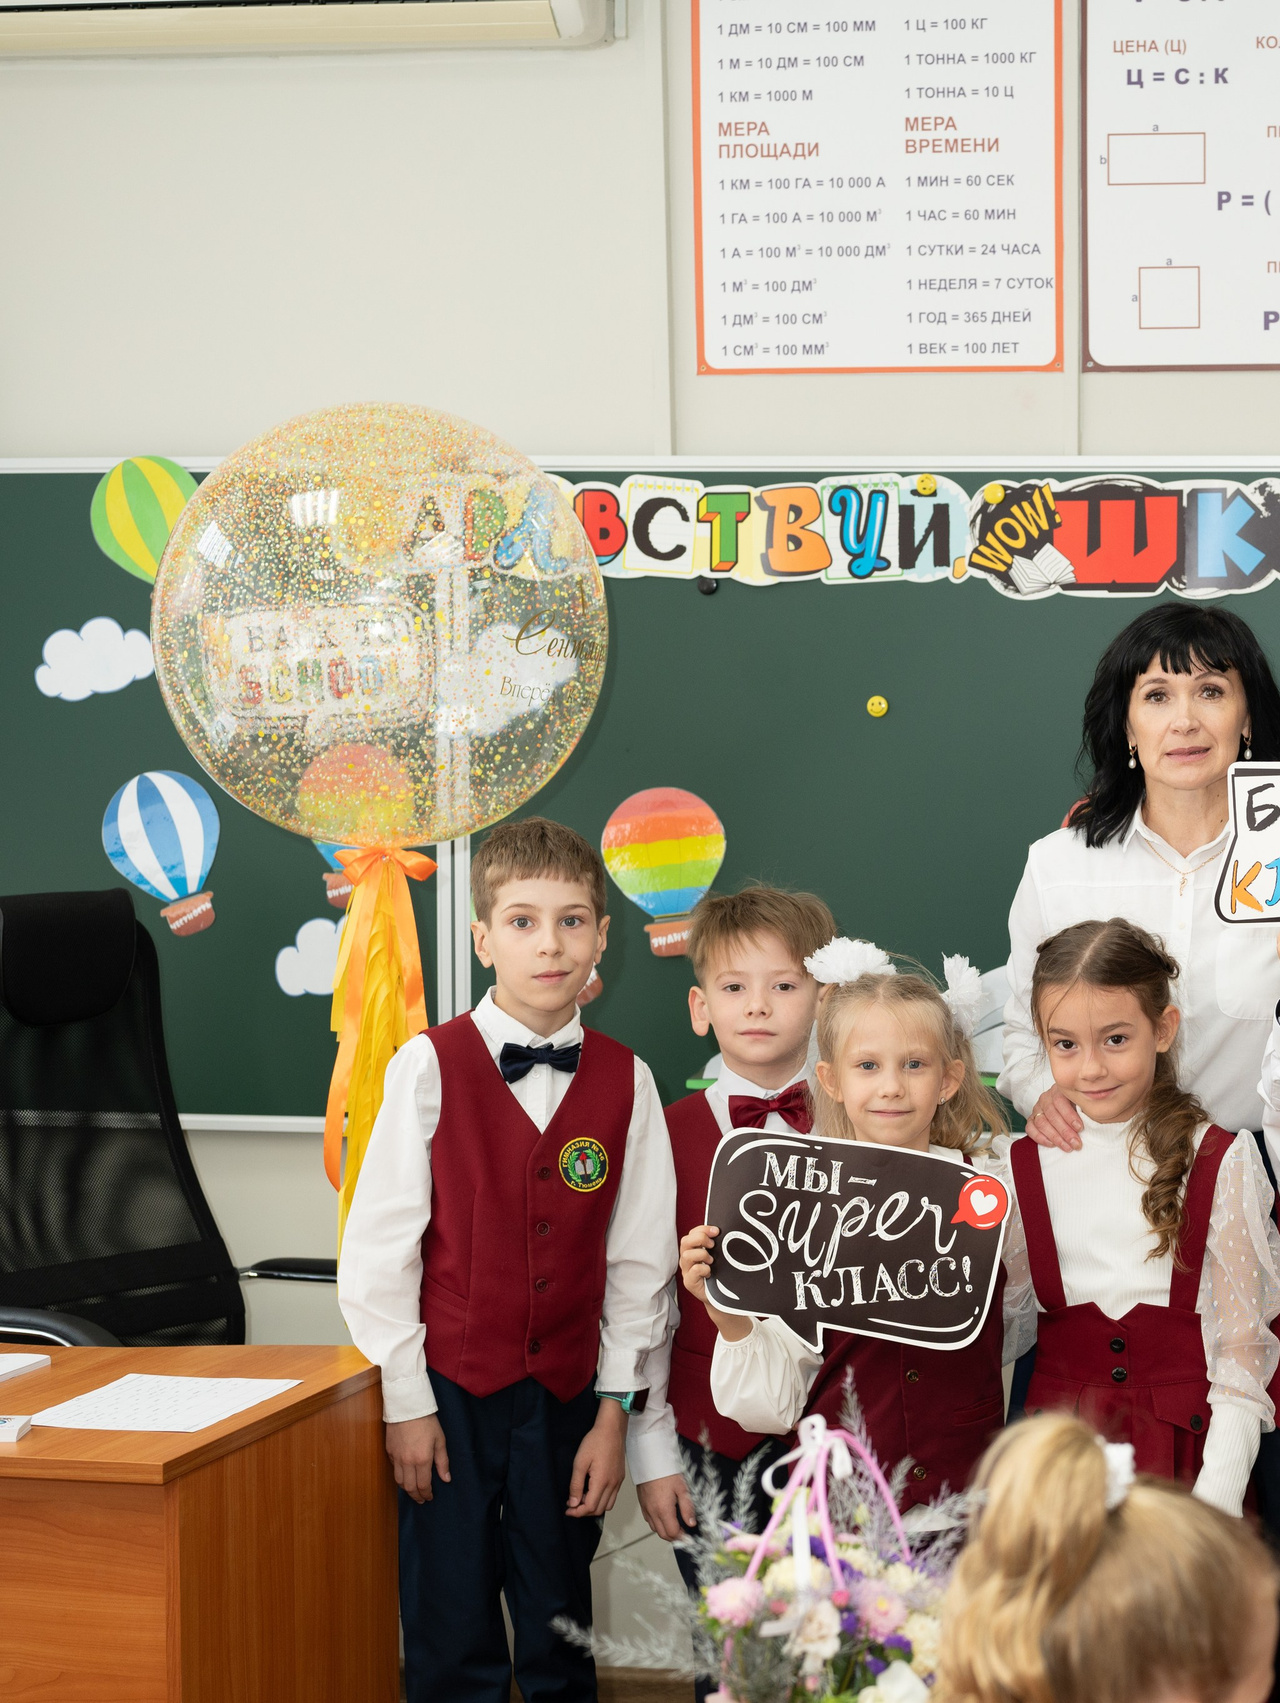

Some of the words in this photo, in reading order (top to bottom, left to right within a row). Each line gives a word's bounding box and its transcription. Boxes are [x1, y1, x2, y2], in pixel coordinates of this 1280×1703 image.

[727, 23, 750, 37] ДМ
[767, 23, 783, 33] 10
[786, 22, 808, 33] СМ
[825, 21, 849, 32] 100
[852, 20, 876, 31] ММ
[915, 19, 927, 32] Ц
[943, 19, 967, 30] 100
[971, 18, 988, 29] КГ
[1112, 40, 1160, 55] ЦЕНА
[1164, 40, 1187, 55] (Ц)
[729, 58, 741, 69] М
[757, 58, 773, 68] 10
[776, 57, 799, 70] ДМ
[815, 56, 839, 67] 100
[842, 56, 865, 67] СМ
[915, 53, 967, 65] ТОННА
[983, 52, 1016, 64] 1000
[1019, 52, 1037, 63] КГ
[729, 91, 750, 102] КМ
[766, 90, 798, 101] 1000
[801, 90, 813, 100] М
[915, 87, 967, 98] ТОННА
[984, 86, 1000, 97] 10
[1003, 86, 1015, 99] Ц
[718, 122, 771, 136] МЕРА
[904, 116, 958, 131] МЕРА
[718, 142, 820, 160] ПЛОЩАДИ
[904, 138, 1000, 154] ВРЕМЕНИ
[730, 179, 751, 190] КМ
[767, 178, 791, 189] 100
[794, 178, 812, 188] ГА
[828, 177, 844, 188] 10
[848, 177, 872, 188] 000
[875, 177, 886, 187] А
[917, 176, 949, 187] МИН
[965, 175, 982, 186] 60
[985, 175, 1015, 186] СЕК
[917, 210, 947, 221] ЧАС
[963, 209, 980, 220] 60
[984, 209, 1016, 220] МИН
[917, 245, 964, 256] СУТКИ
[980, 244, 997, 255] 24
[1000, 243, 1042, 254] ЧАСА
[918, 278, 978, 292] НЕДЕЛЯ
[994, 278, 1002, 289] 7
[1006, 278, 1054, 289] СУТОК
[918, 312, 948, 325] ГОД
[963, 312, 988, 323] 365
[990, 309, 1032, 324] ДНЕЙ
[918, 343, 947, 354] ВЕК
[964, 343, 987, 353] 100
[991, 342, 1020, 353] ЛЕТ
[970, 482, 1062, 572] WOW!
[562, 1141, 590, 1168] ГИМНАЗИЯ
[721, 1189, 958, 1284] Super
[791, 1255, 974, 1312] КЛАСС!
